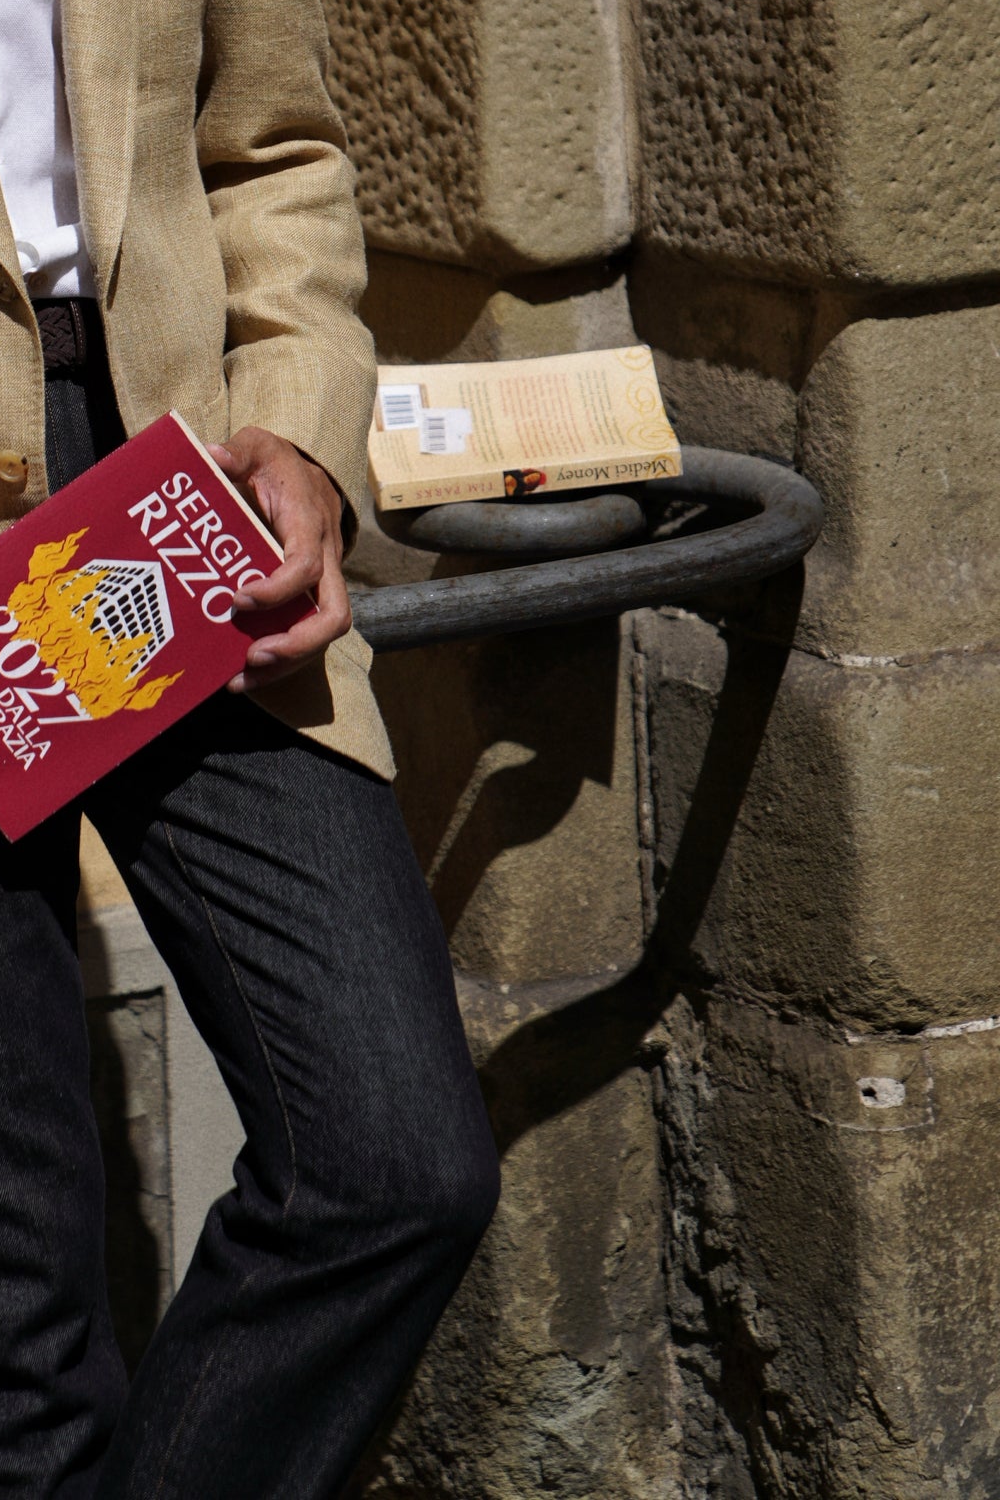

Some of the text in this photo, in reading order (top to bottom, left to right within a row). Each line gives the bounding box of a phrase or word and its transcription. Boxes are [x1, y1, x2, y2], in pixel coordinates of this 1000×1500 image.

[557, 459, 668, 482] Medici Money
[415, 482, 493, 499] TIM PARKS
[127, 491, 235, 624] RIZZO
